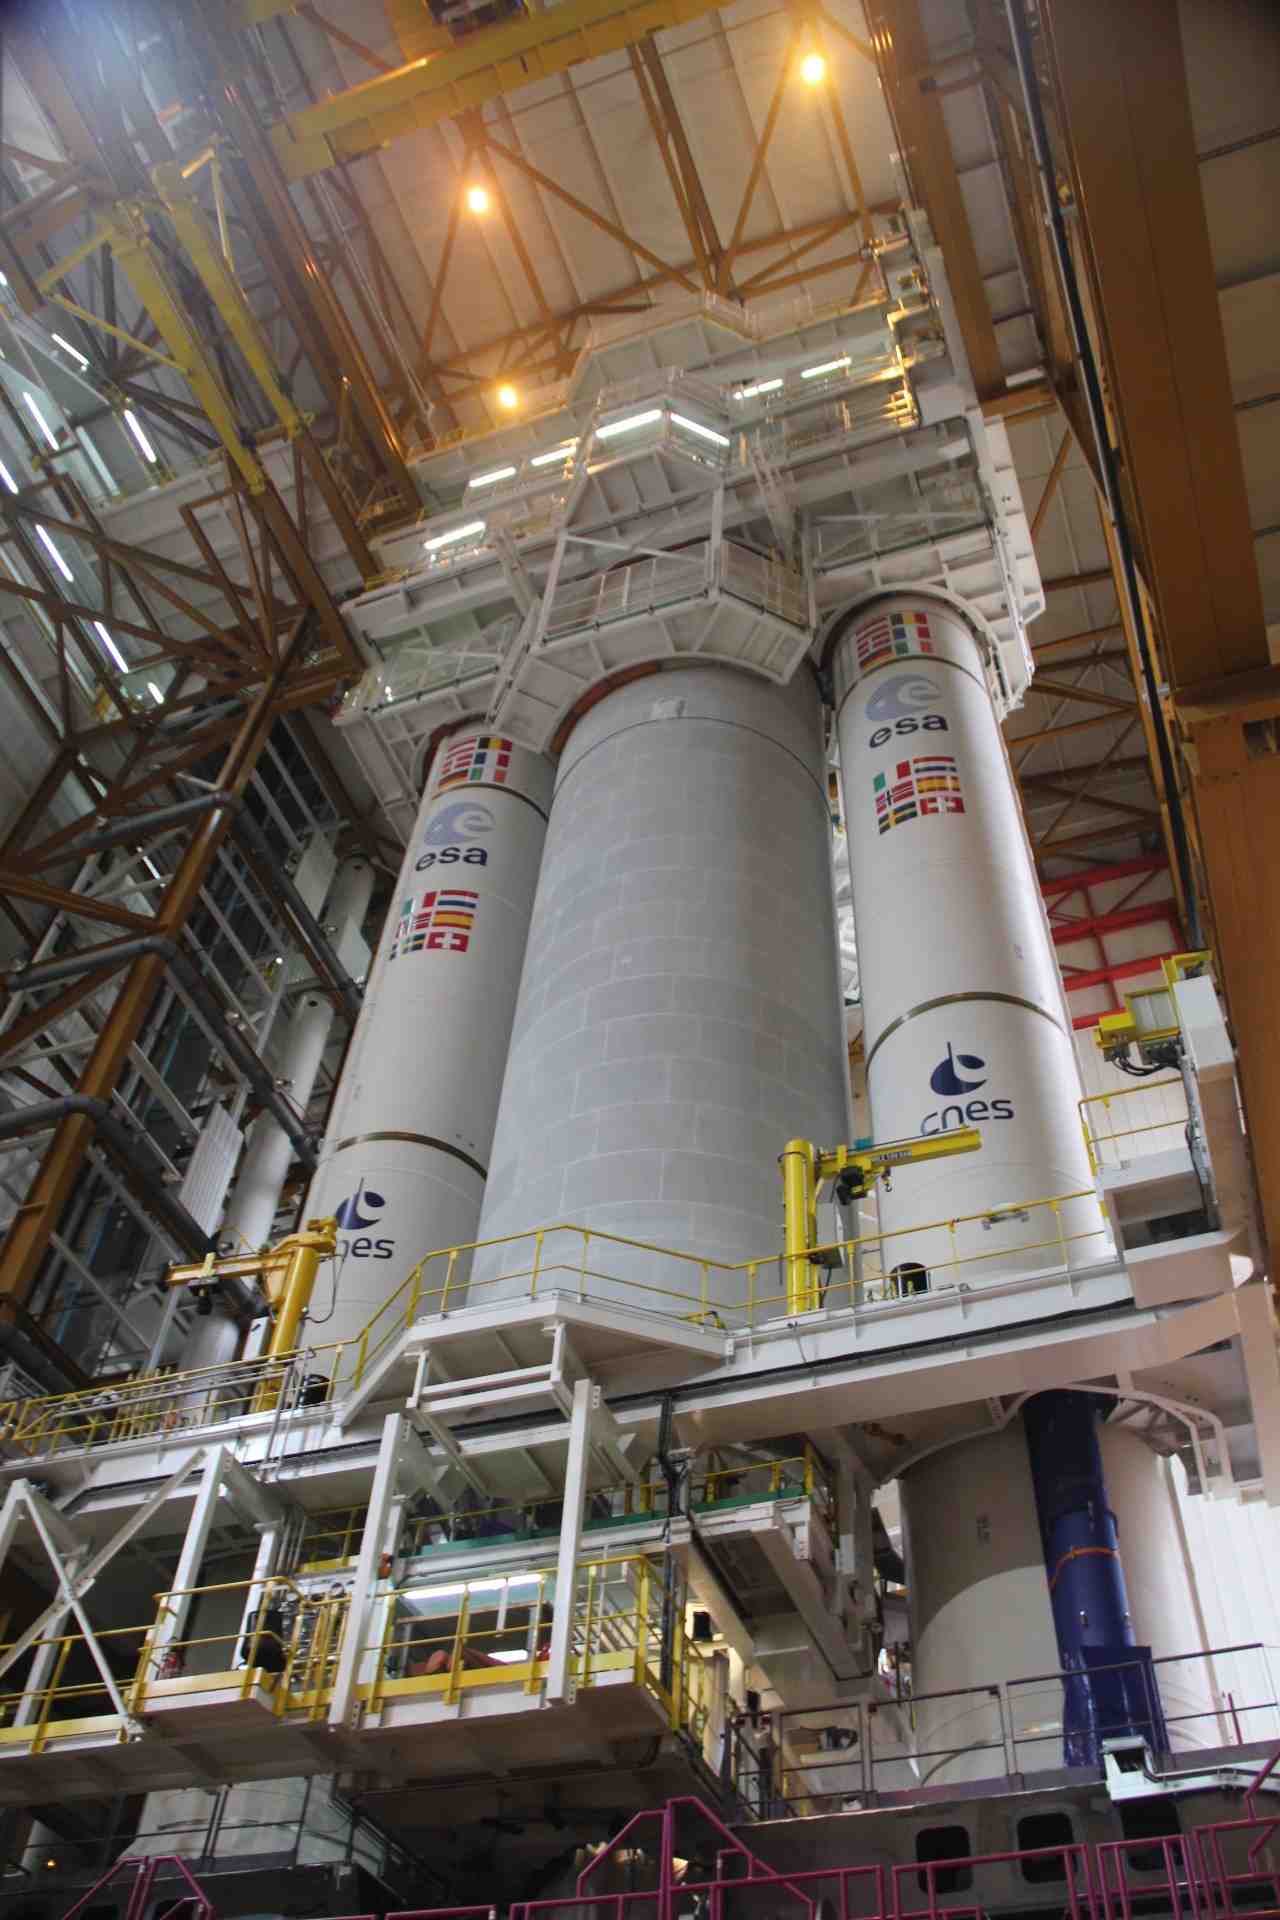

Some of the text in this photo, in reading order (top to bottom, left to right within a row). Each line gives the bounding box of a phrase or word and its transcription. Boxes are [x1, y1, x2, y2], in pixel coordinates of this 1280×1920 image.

[869, 714, 948, 748] esa
[415, 846, 488, 872] esa
[920, 1099, 1014, 1136] cnes
